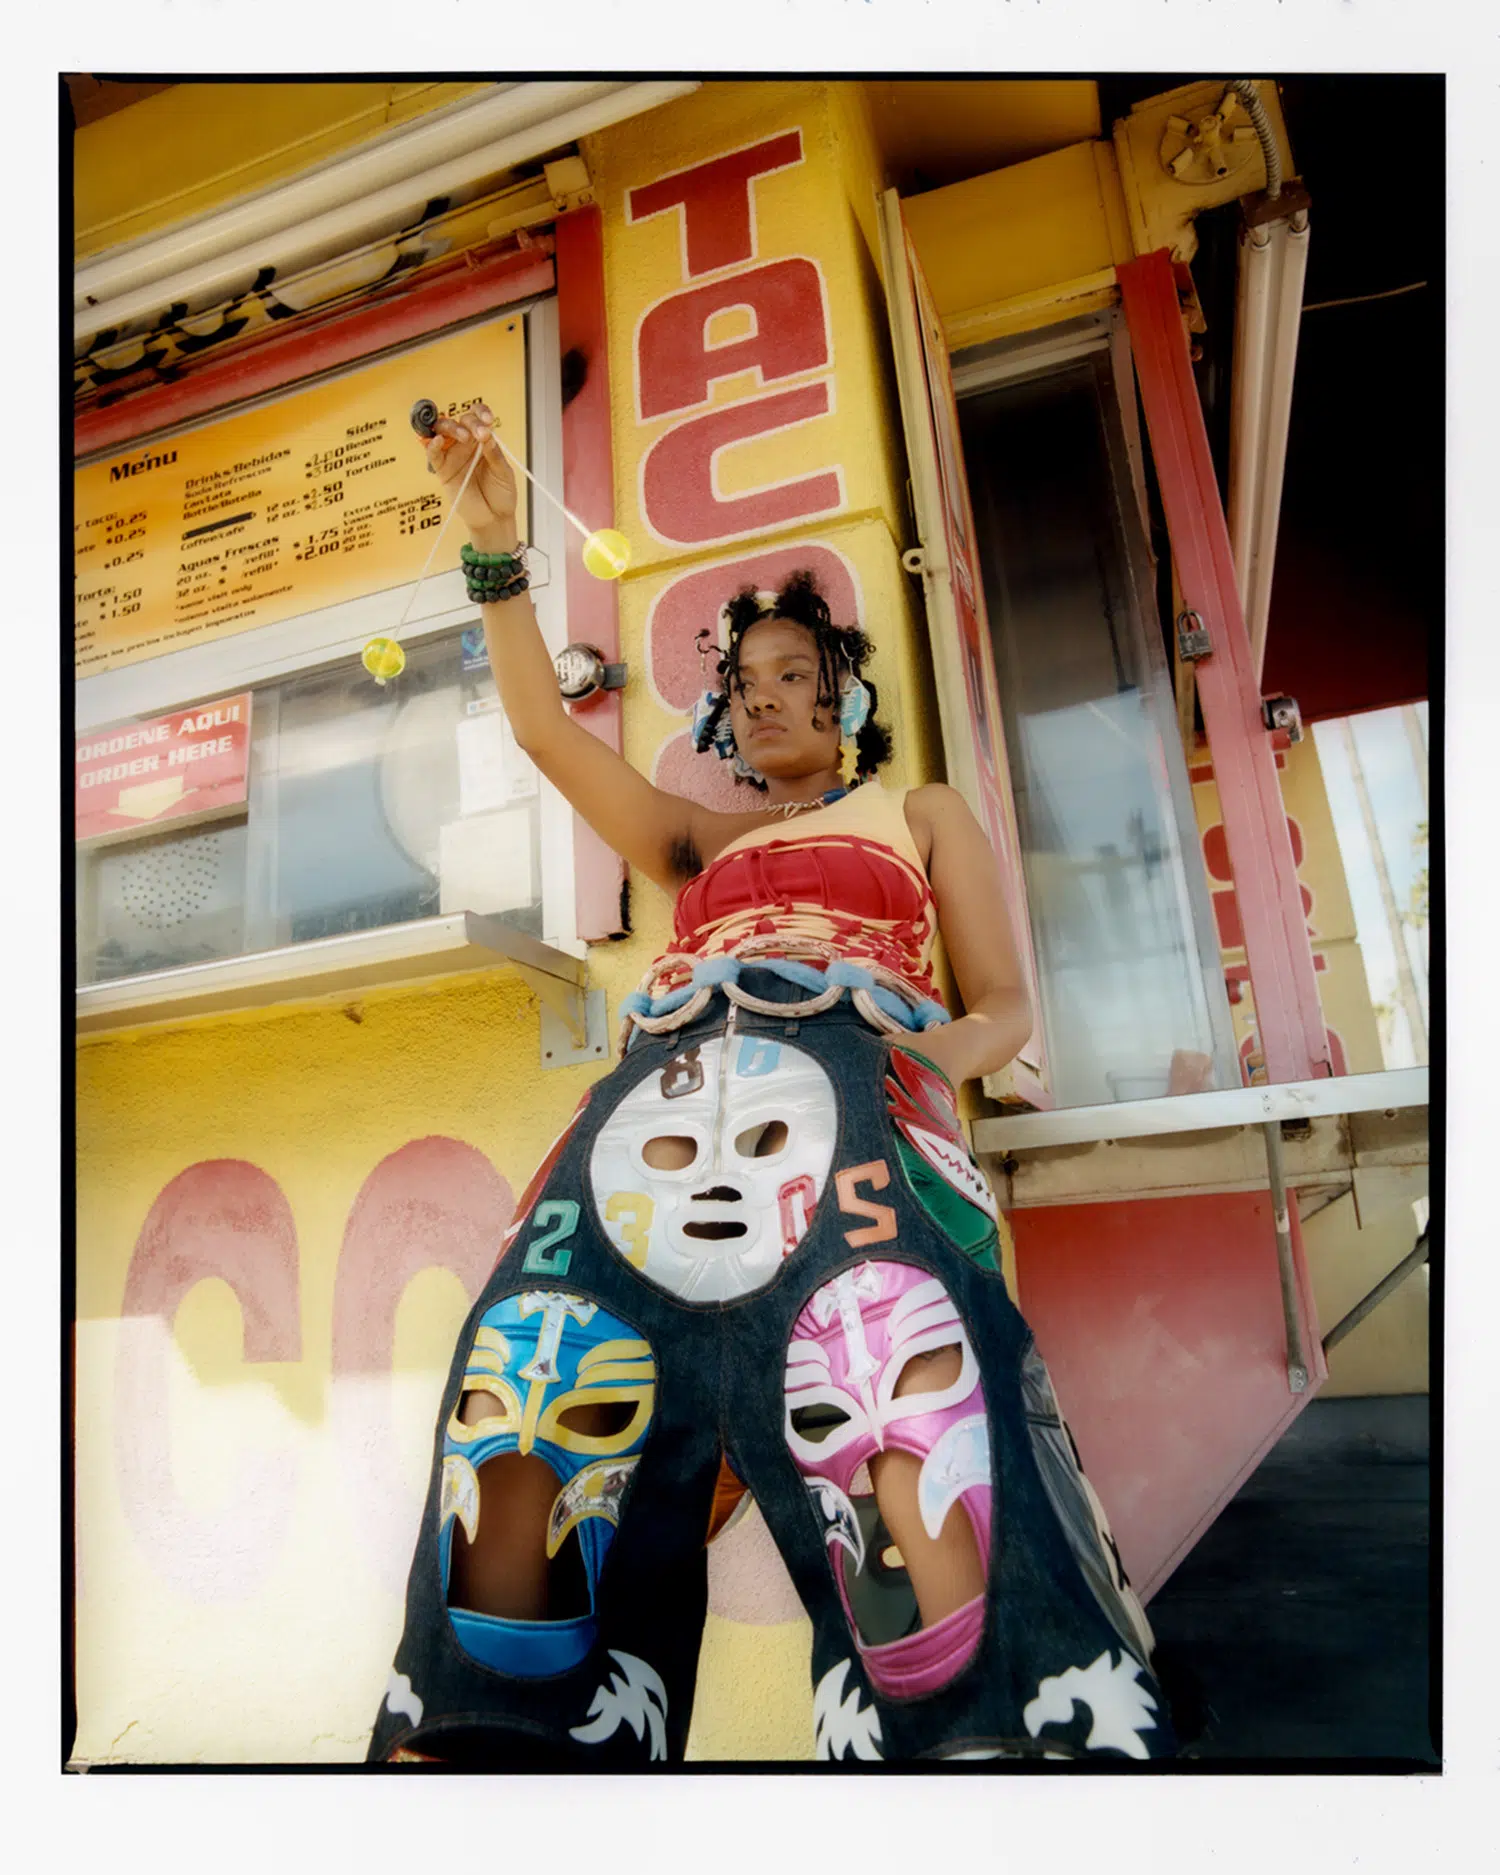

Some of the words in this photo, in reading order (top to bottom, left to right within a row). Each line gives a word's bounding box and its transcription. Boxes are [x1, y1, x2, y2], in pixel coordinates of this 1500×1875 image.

[346, 418, 387, 440] Sides
[346, 434, 383, 451] Beans
[345, 451, 371, 464] Rice
[345, 456, 396, 477] Tortillas
[177, 555, 220, 573] Aguas
[225, 537, 279, 558] Frescas
[76, 724, 170, 763] ORDENE
[177, 705, 240, 736] AQUI
[79, 754, 159, 789] ORDER
[168, 735, 233, 767] HERE
[522, 1199, 581, 1277] 2
